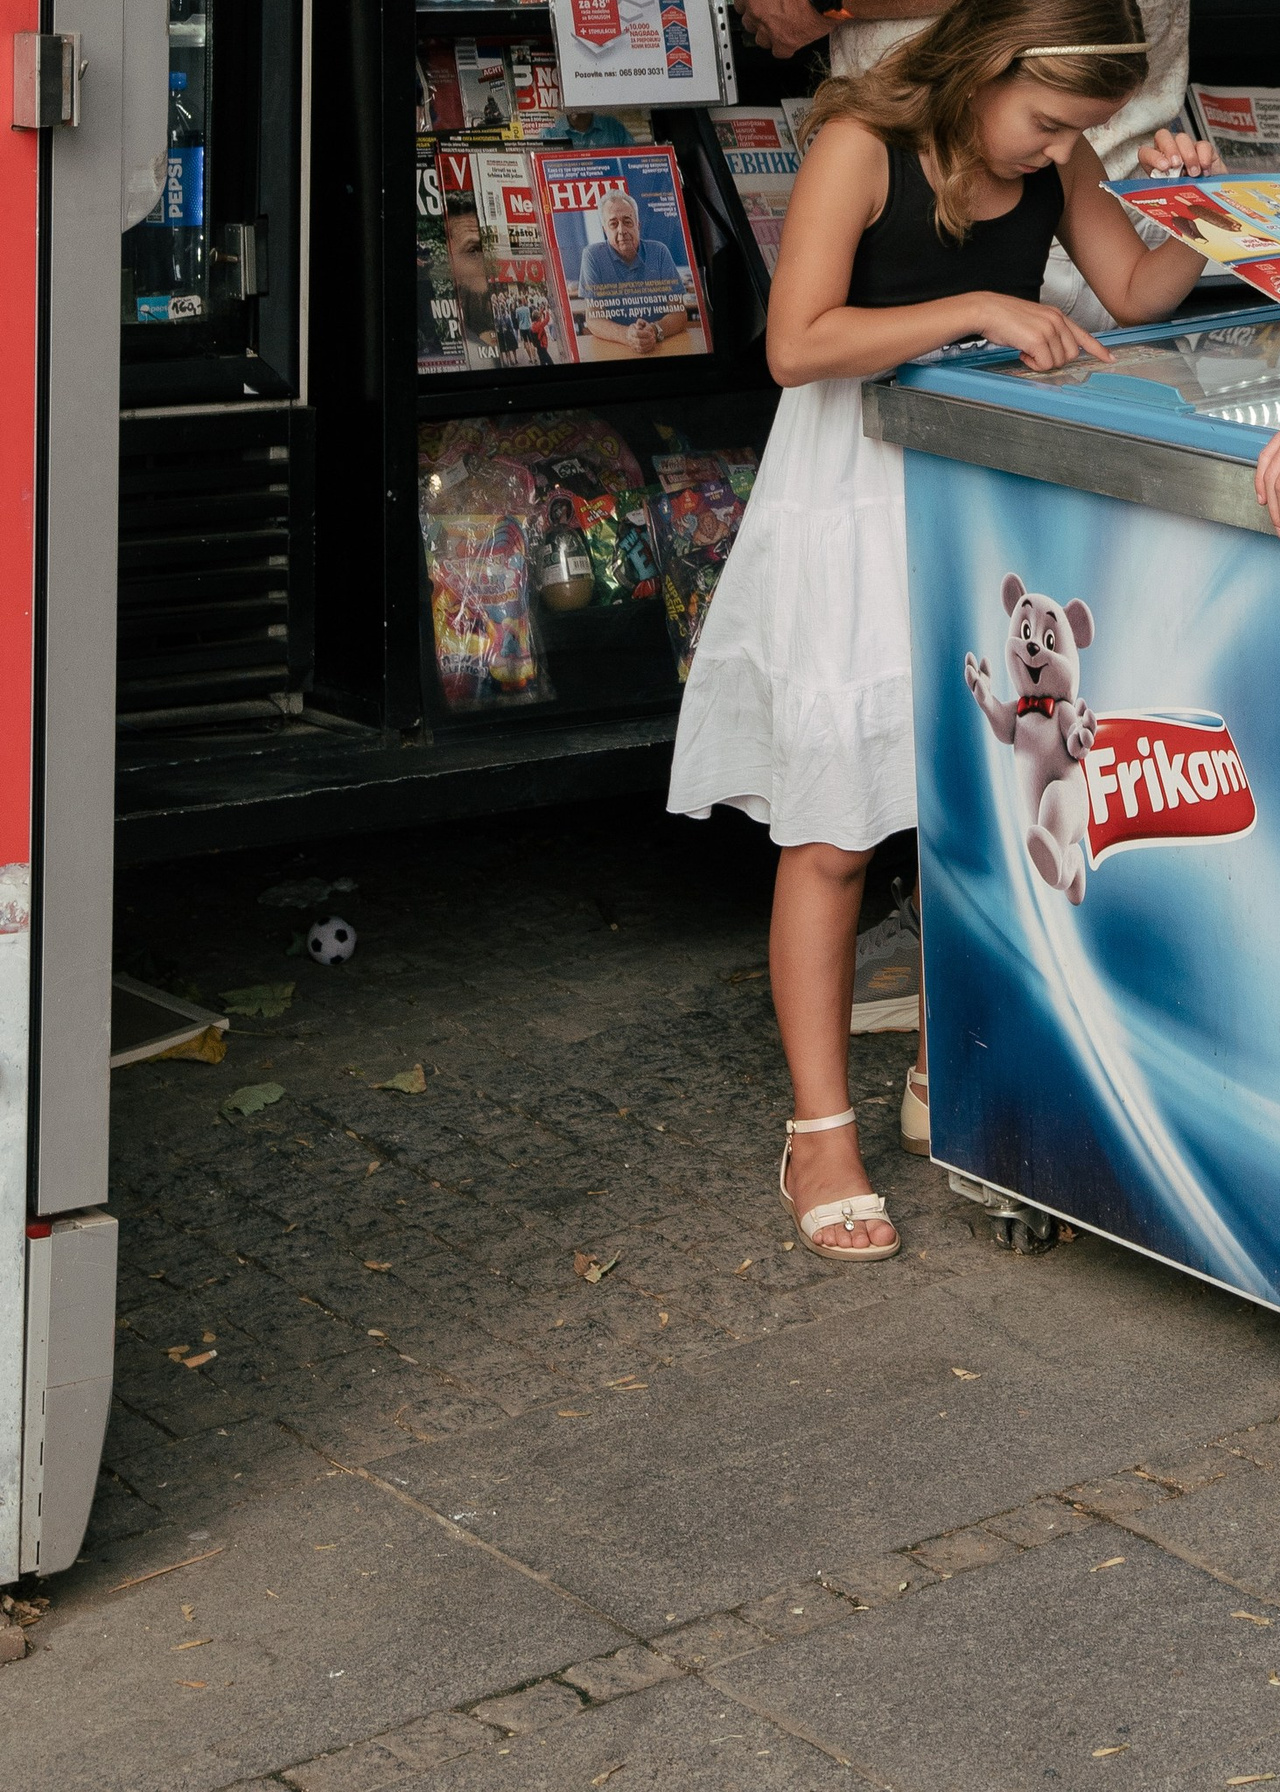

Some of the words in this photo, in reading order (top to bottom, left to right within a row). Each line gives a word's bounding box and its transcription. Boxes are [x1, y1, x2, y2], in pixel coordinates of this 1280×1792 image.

[578, 0, 590, 9] za
[574, 71, 603, 79] Pozovite
[619, 68, 633, 76] 065
[632, 68, 647, 76] 890
[647, 67, 665, 76] 3031
[168, 157, 183, 219] PEPSI
[509, 194, 533, 213] Ne
[509, 228, 533, 237] Zašto
[586, 297, 620, 308] Морамо
[622, 295, 667, 306] поштовати
[668, 293, 684, 303] ову
[588, 309, 627, 319] младост,
[628, 306, 652, 318] другу
[653, 304, 685, 314] немамо
[1085, 735, 1247, 825] Frikom
